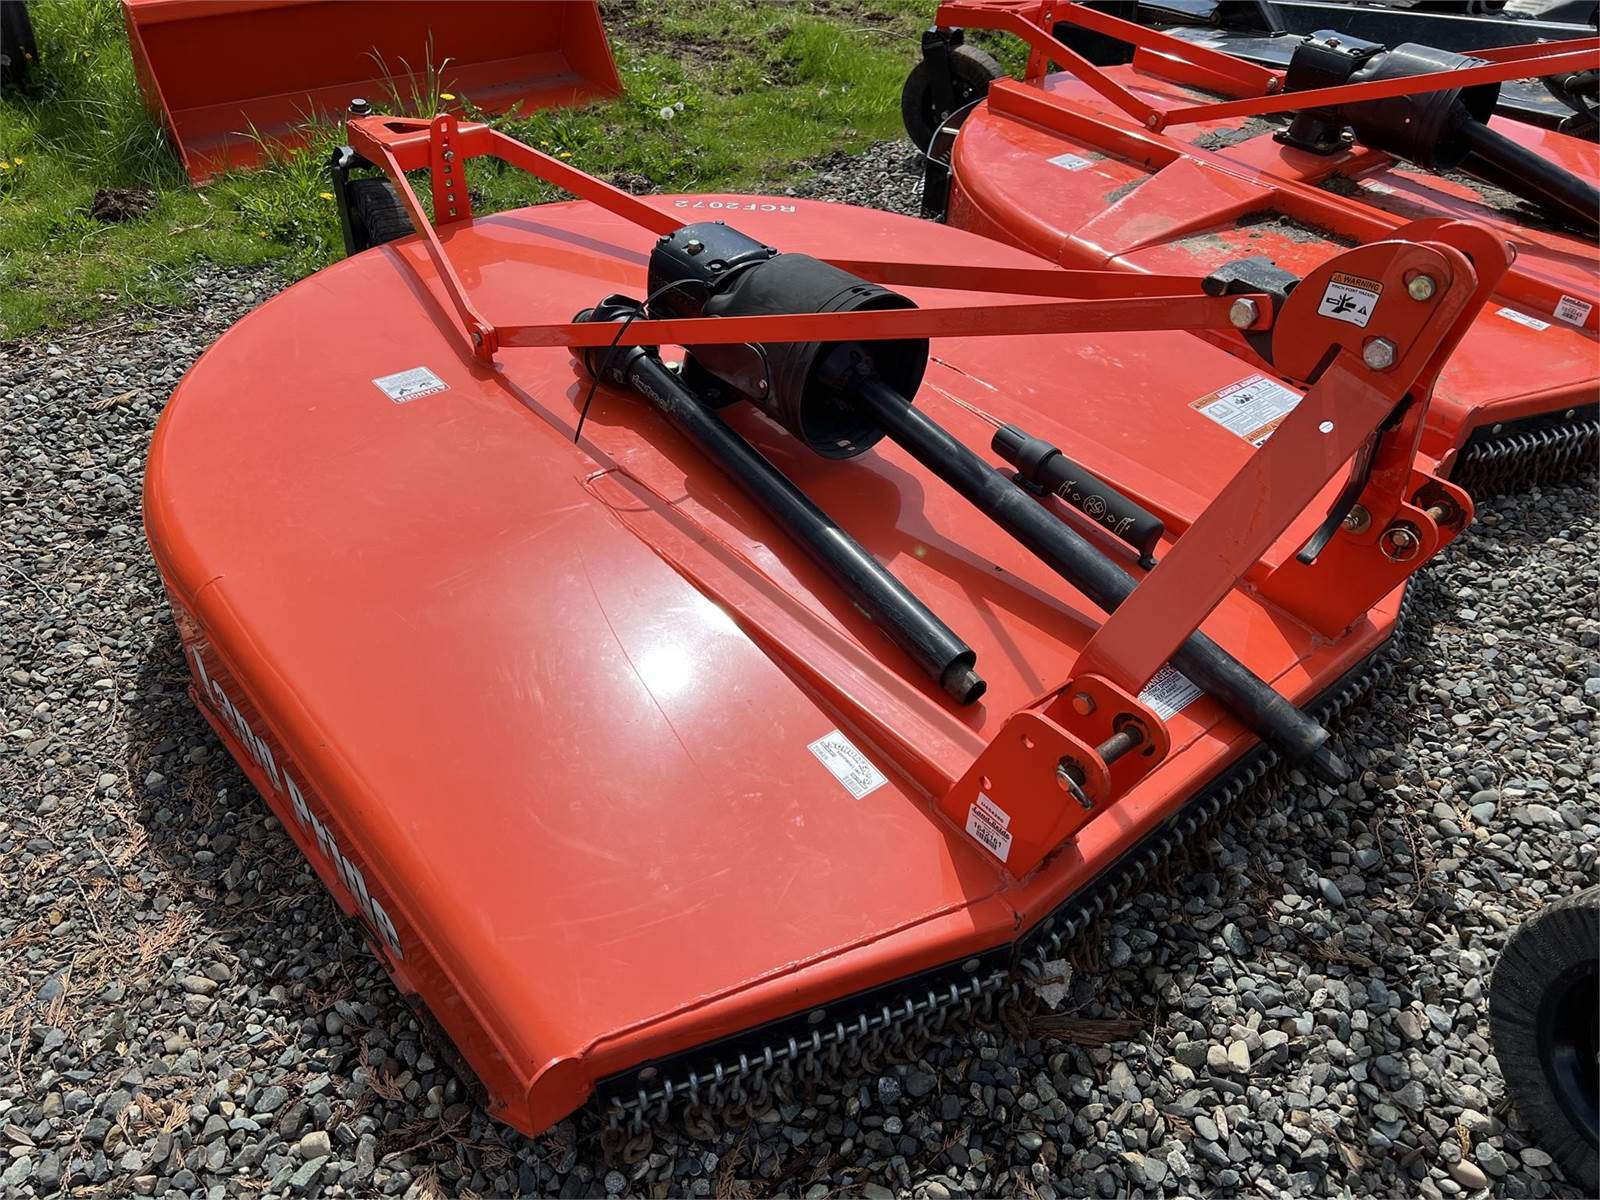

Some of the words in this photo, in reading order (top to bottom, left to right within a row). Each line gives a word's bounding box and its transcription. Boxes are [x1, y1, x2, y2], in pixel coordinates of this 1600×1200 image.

[674, 200, 797, 213] RCF2072
[1343, 275, 1381, 291] WARNING
[1358, 290, 1377, 299] HAZARD
[1143, 665, 1175, 691] DANGER
